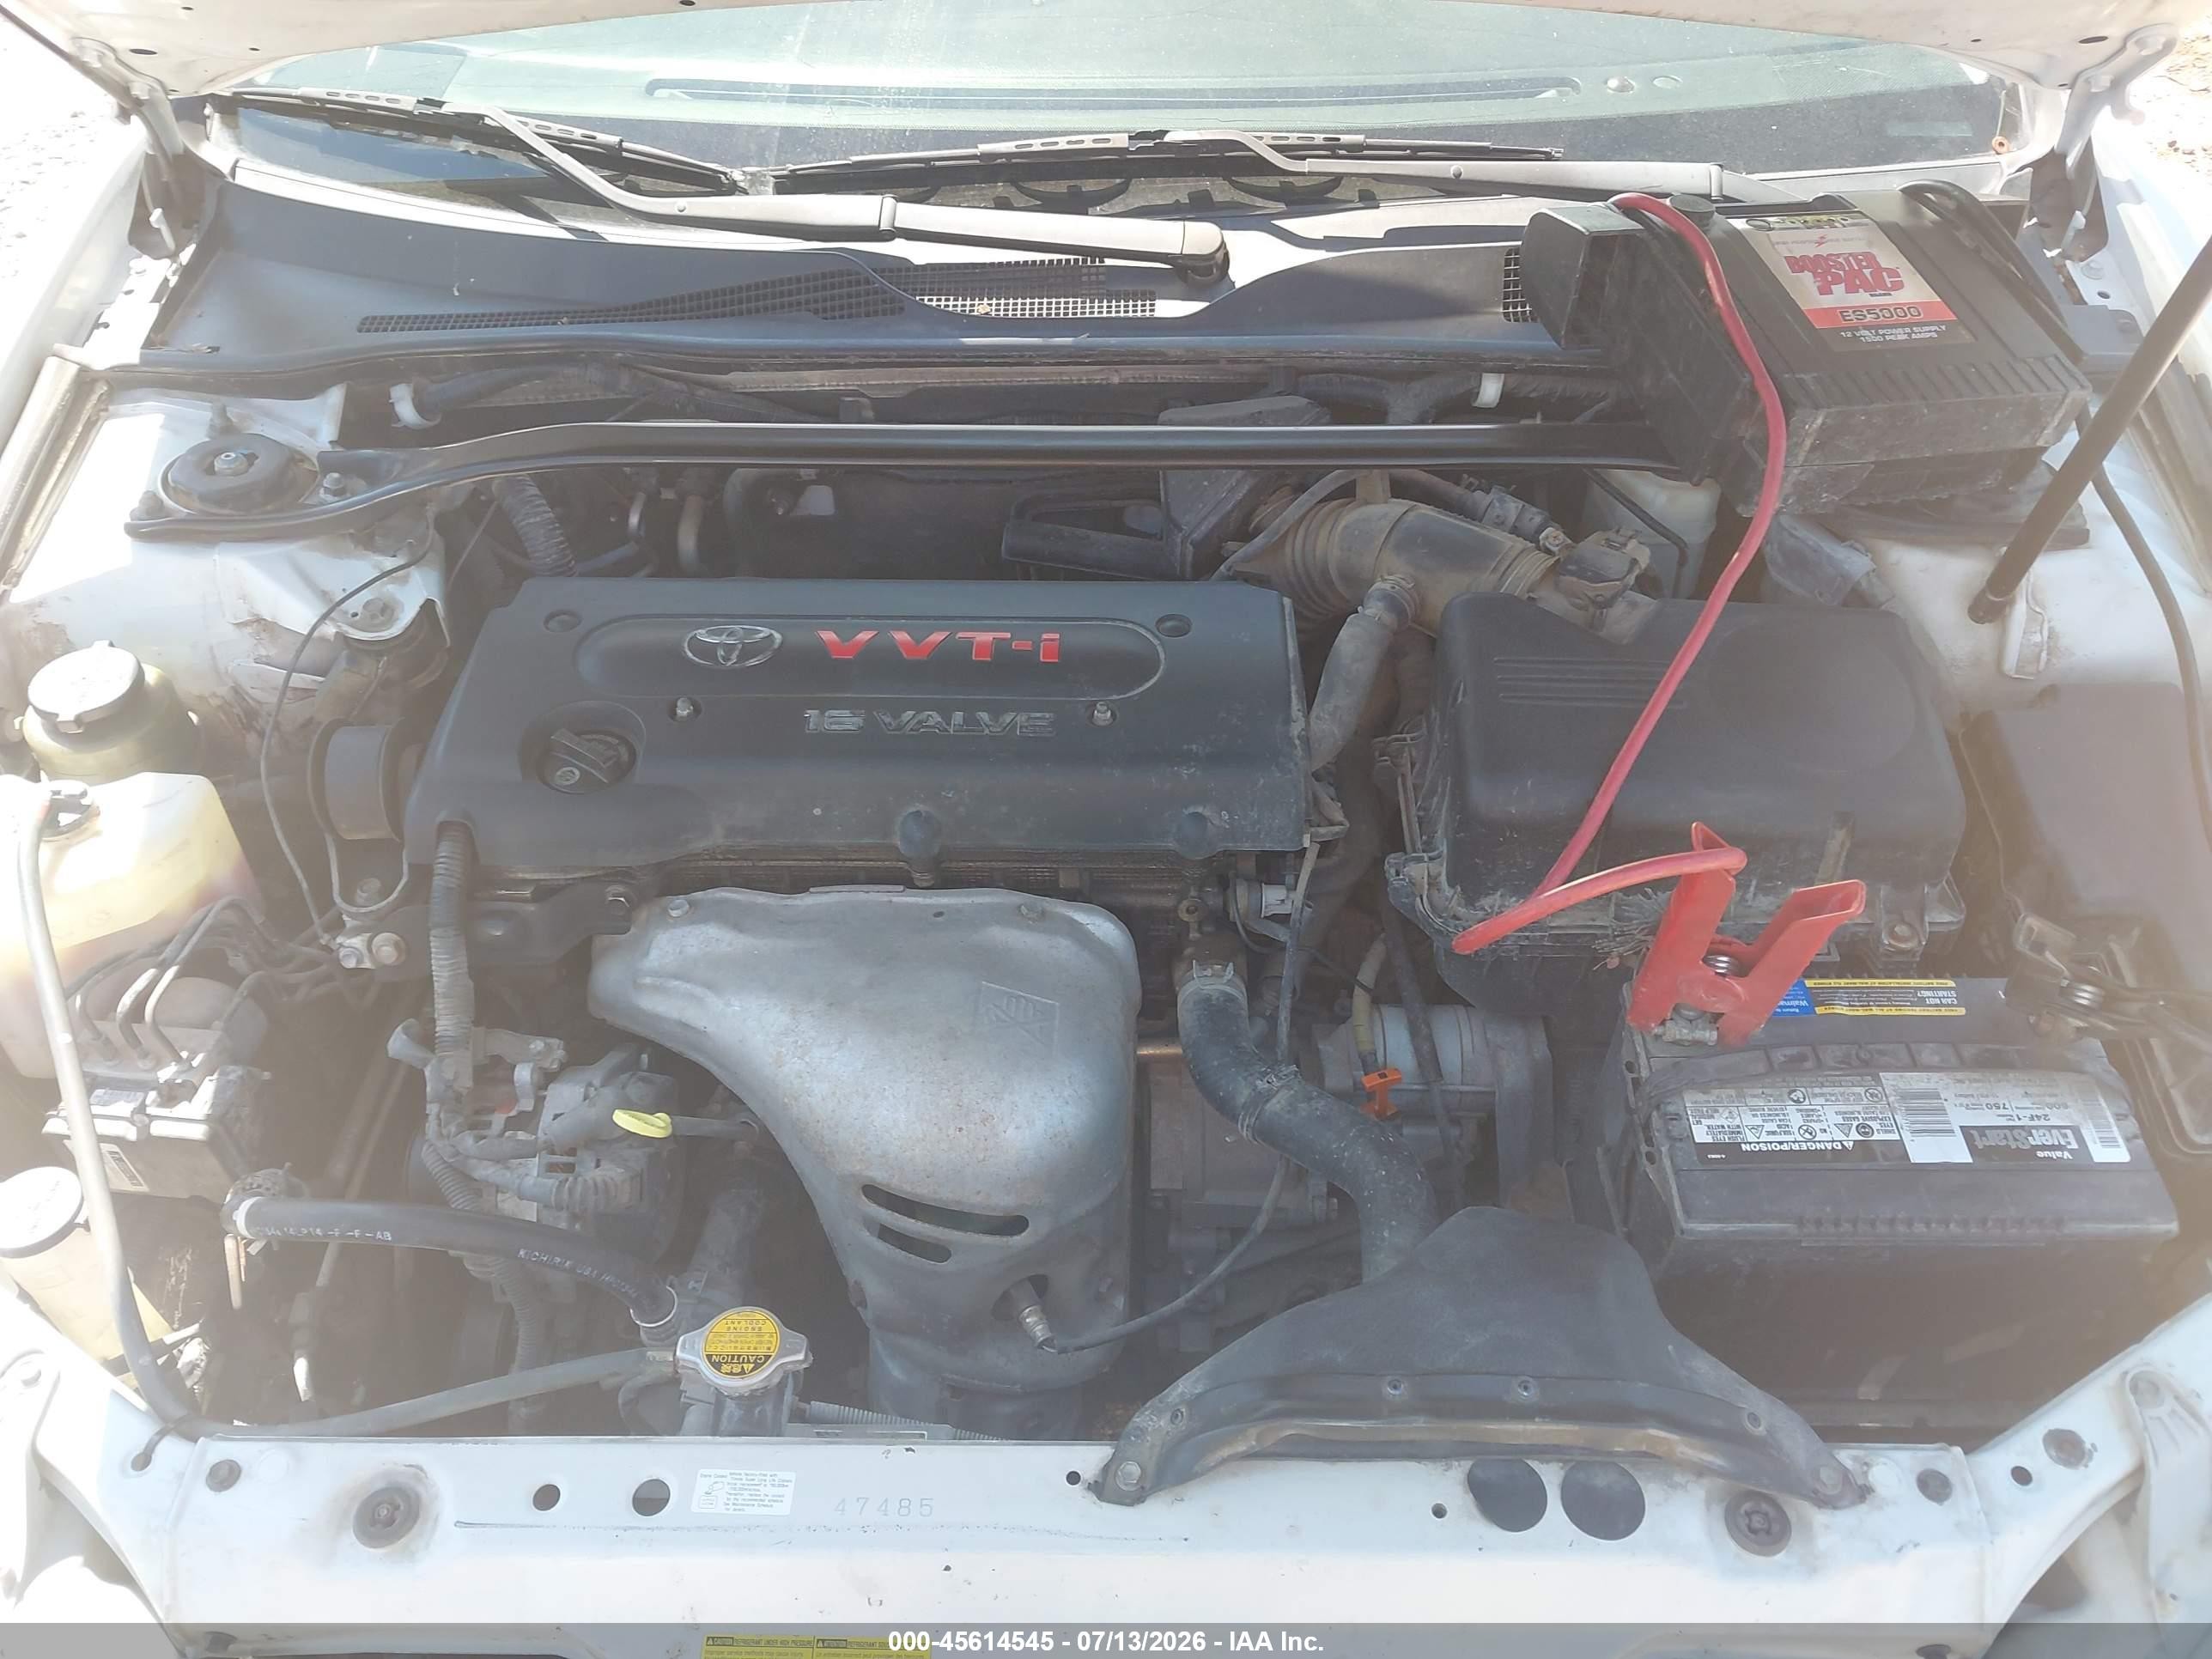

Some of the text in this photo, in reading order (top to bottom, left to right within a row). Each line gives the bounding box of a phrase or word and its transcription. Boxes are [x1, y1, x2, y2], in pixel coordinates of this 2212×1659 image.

[1784, 252, 1882, 274] BOOSTER
[1814, 267, 1905, 296] PAC
[1838, 306, 1923, 323] ES5000
[1854, 329, 1876, 337] VOLT
[1878, 327, 1911, 336] POWER
[1912, 325, 1947, 333] SUPPLY
[814, 630, 1061, 662] VVT-i
[804, 709, 1057, 737] 16 VALVE
[2016, 1114, 2051, 1122] 24F-1
[1740, 1141, 1843, 1152] DANGER/POISON
[1969, 1129, 2079, 1150] EverStart
[2035, 1151, 2073, 1160] Value
[711, 1355, 765, 1364] CAUTION
[834, 1497, 934, 1517] 47485
